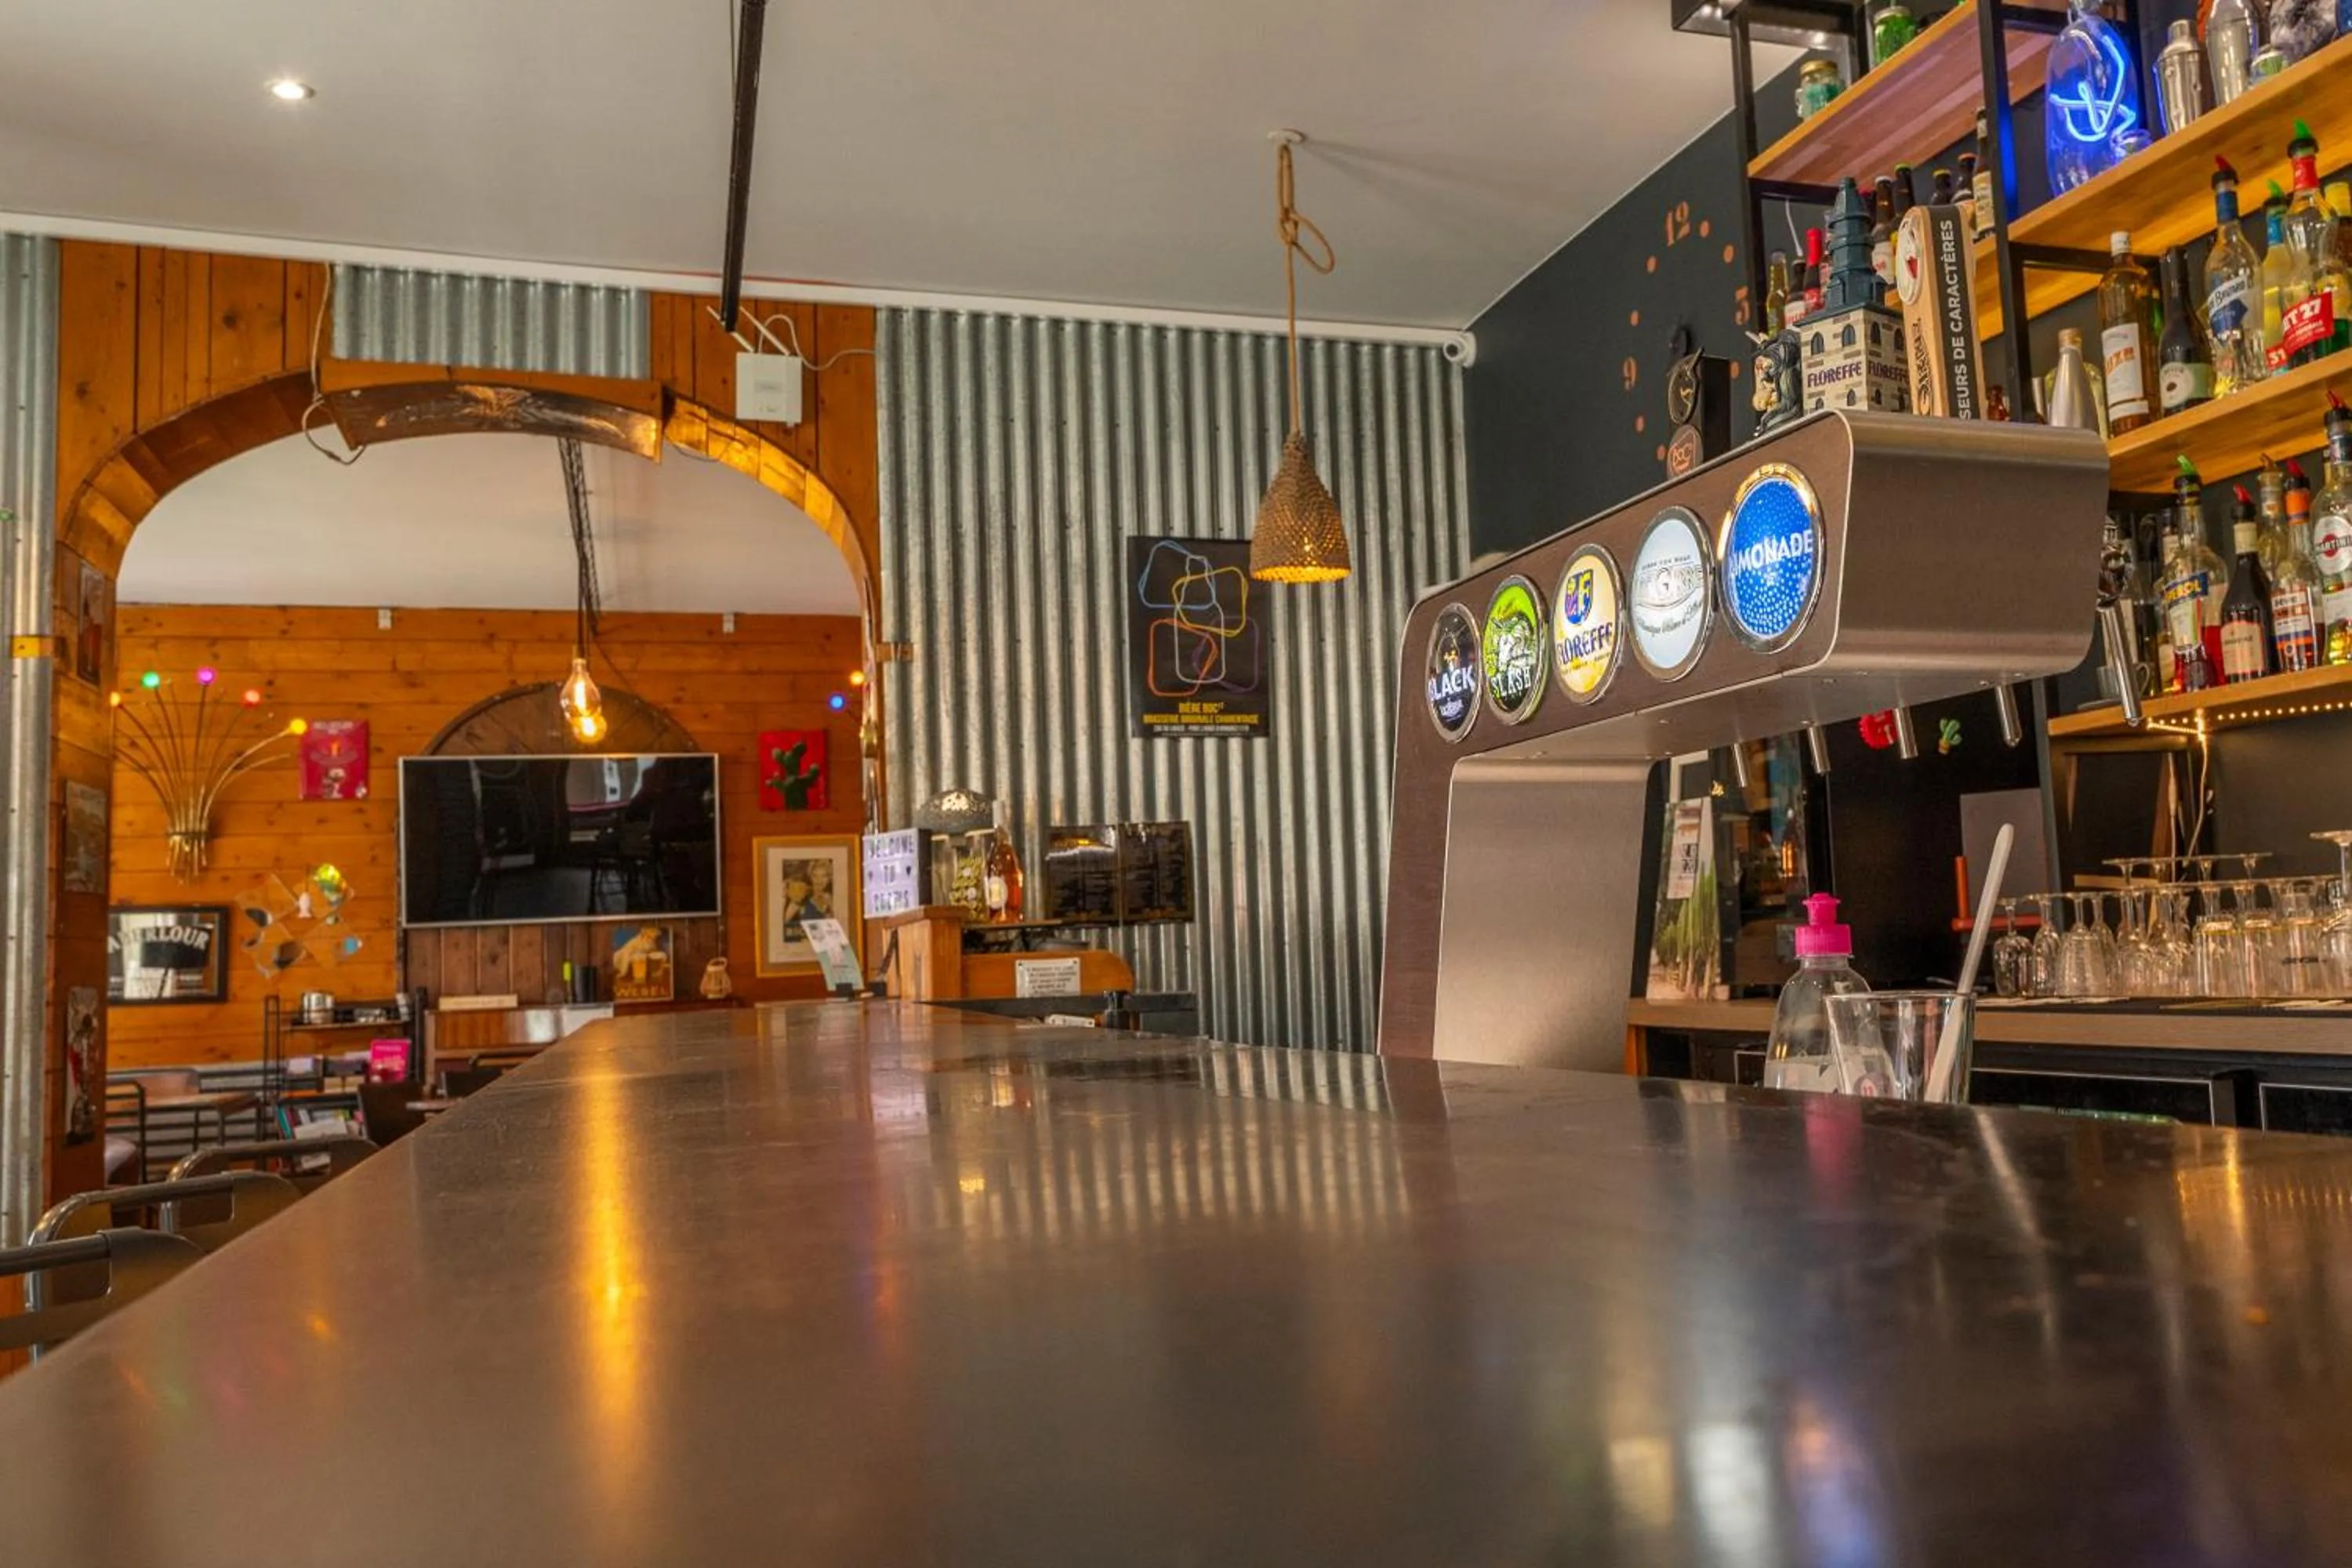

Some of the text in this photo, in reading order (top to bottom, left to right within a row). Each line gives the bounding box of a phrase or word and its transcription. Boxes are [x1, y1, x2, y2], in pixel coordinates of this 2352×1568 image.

[1666, 200, 1691, 247] 12
[1940, 220, 1963, 332] CARACTÈRES
[2299, 297, 2322, 321] 27
[1952, 335, 1966, 359] DE
[1623, 356, 1637, 391] 9
[1807, 361, 1862, 388] FLOREFFE
[1490, 665, 1531, 699] SLASH
